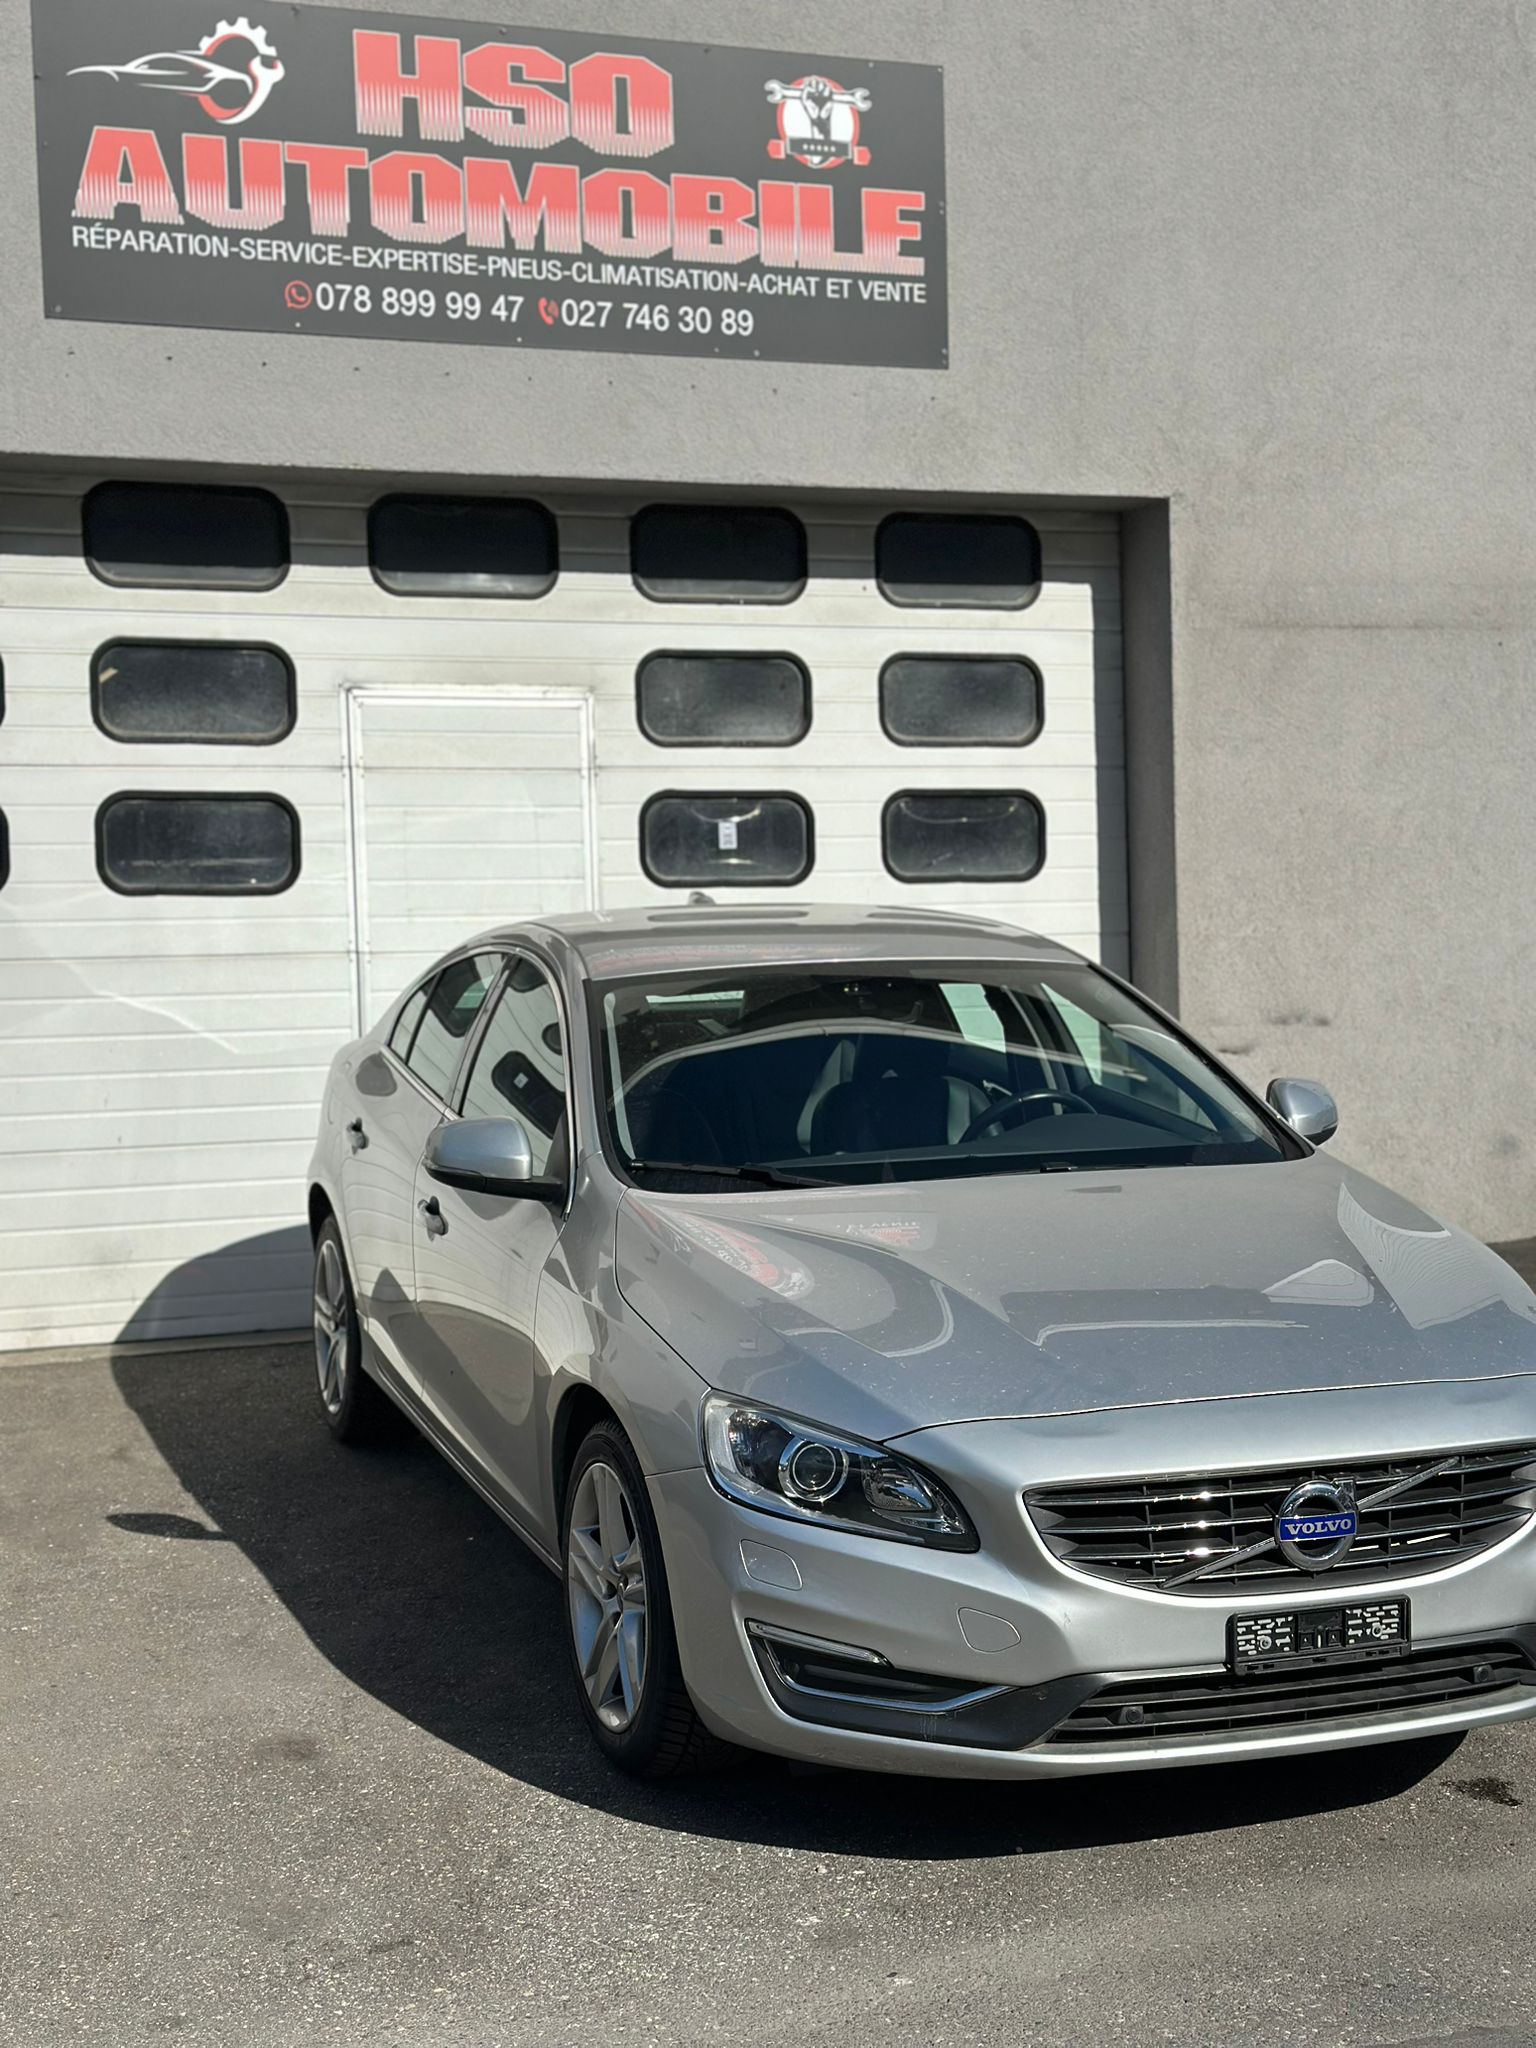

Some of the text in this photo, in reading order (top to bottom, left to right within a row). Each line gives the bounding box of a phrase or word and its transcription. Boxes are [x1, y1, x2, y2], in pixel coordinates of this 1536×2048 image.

[353, 29, 674, 157] HSO
[71, 126, 926, 277] AUTOMOBILE
[315, 283, 525, 323] 078 899 99 47
[826, 277, 853, 300] ET
[858, 280, 927, 305] VENTE
[561, 301, 755, 337] 027 746 30 89
[1285, 1519, 1352, 1535] VOLVO
